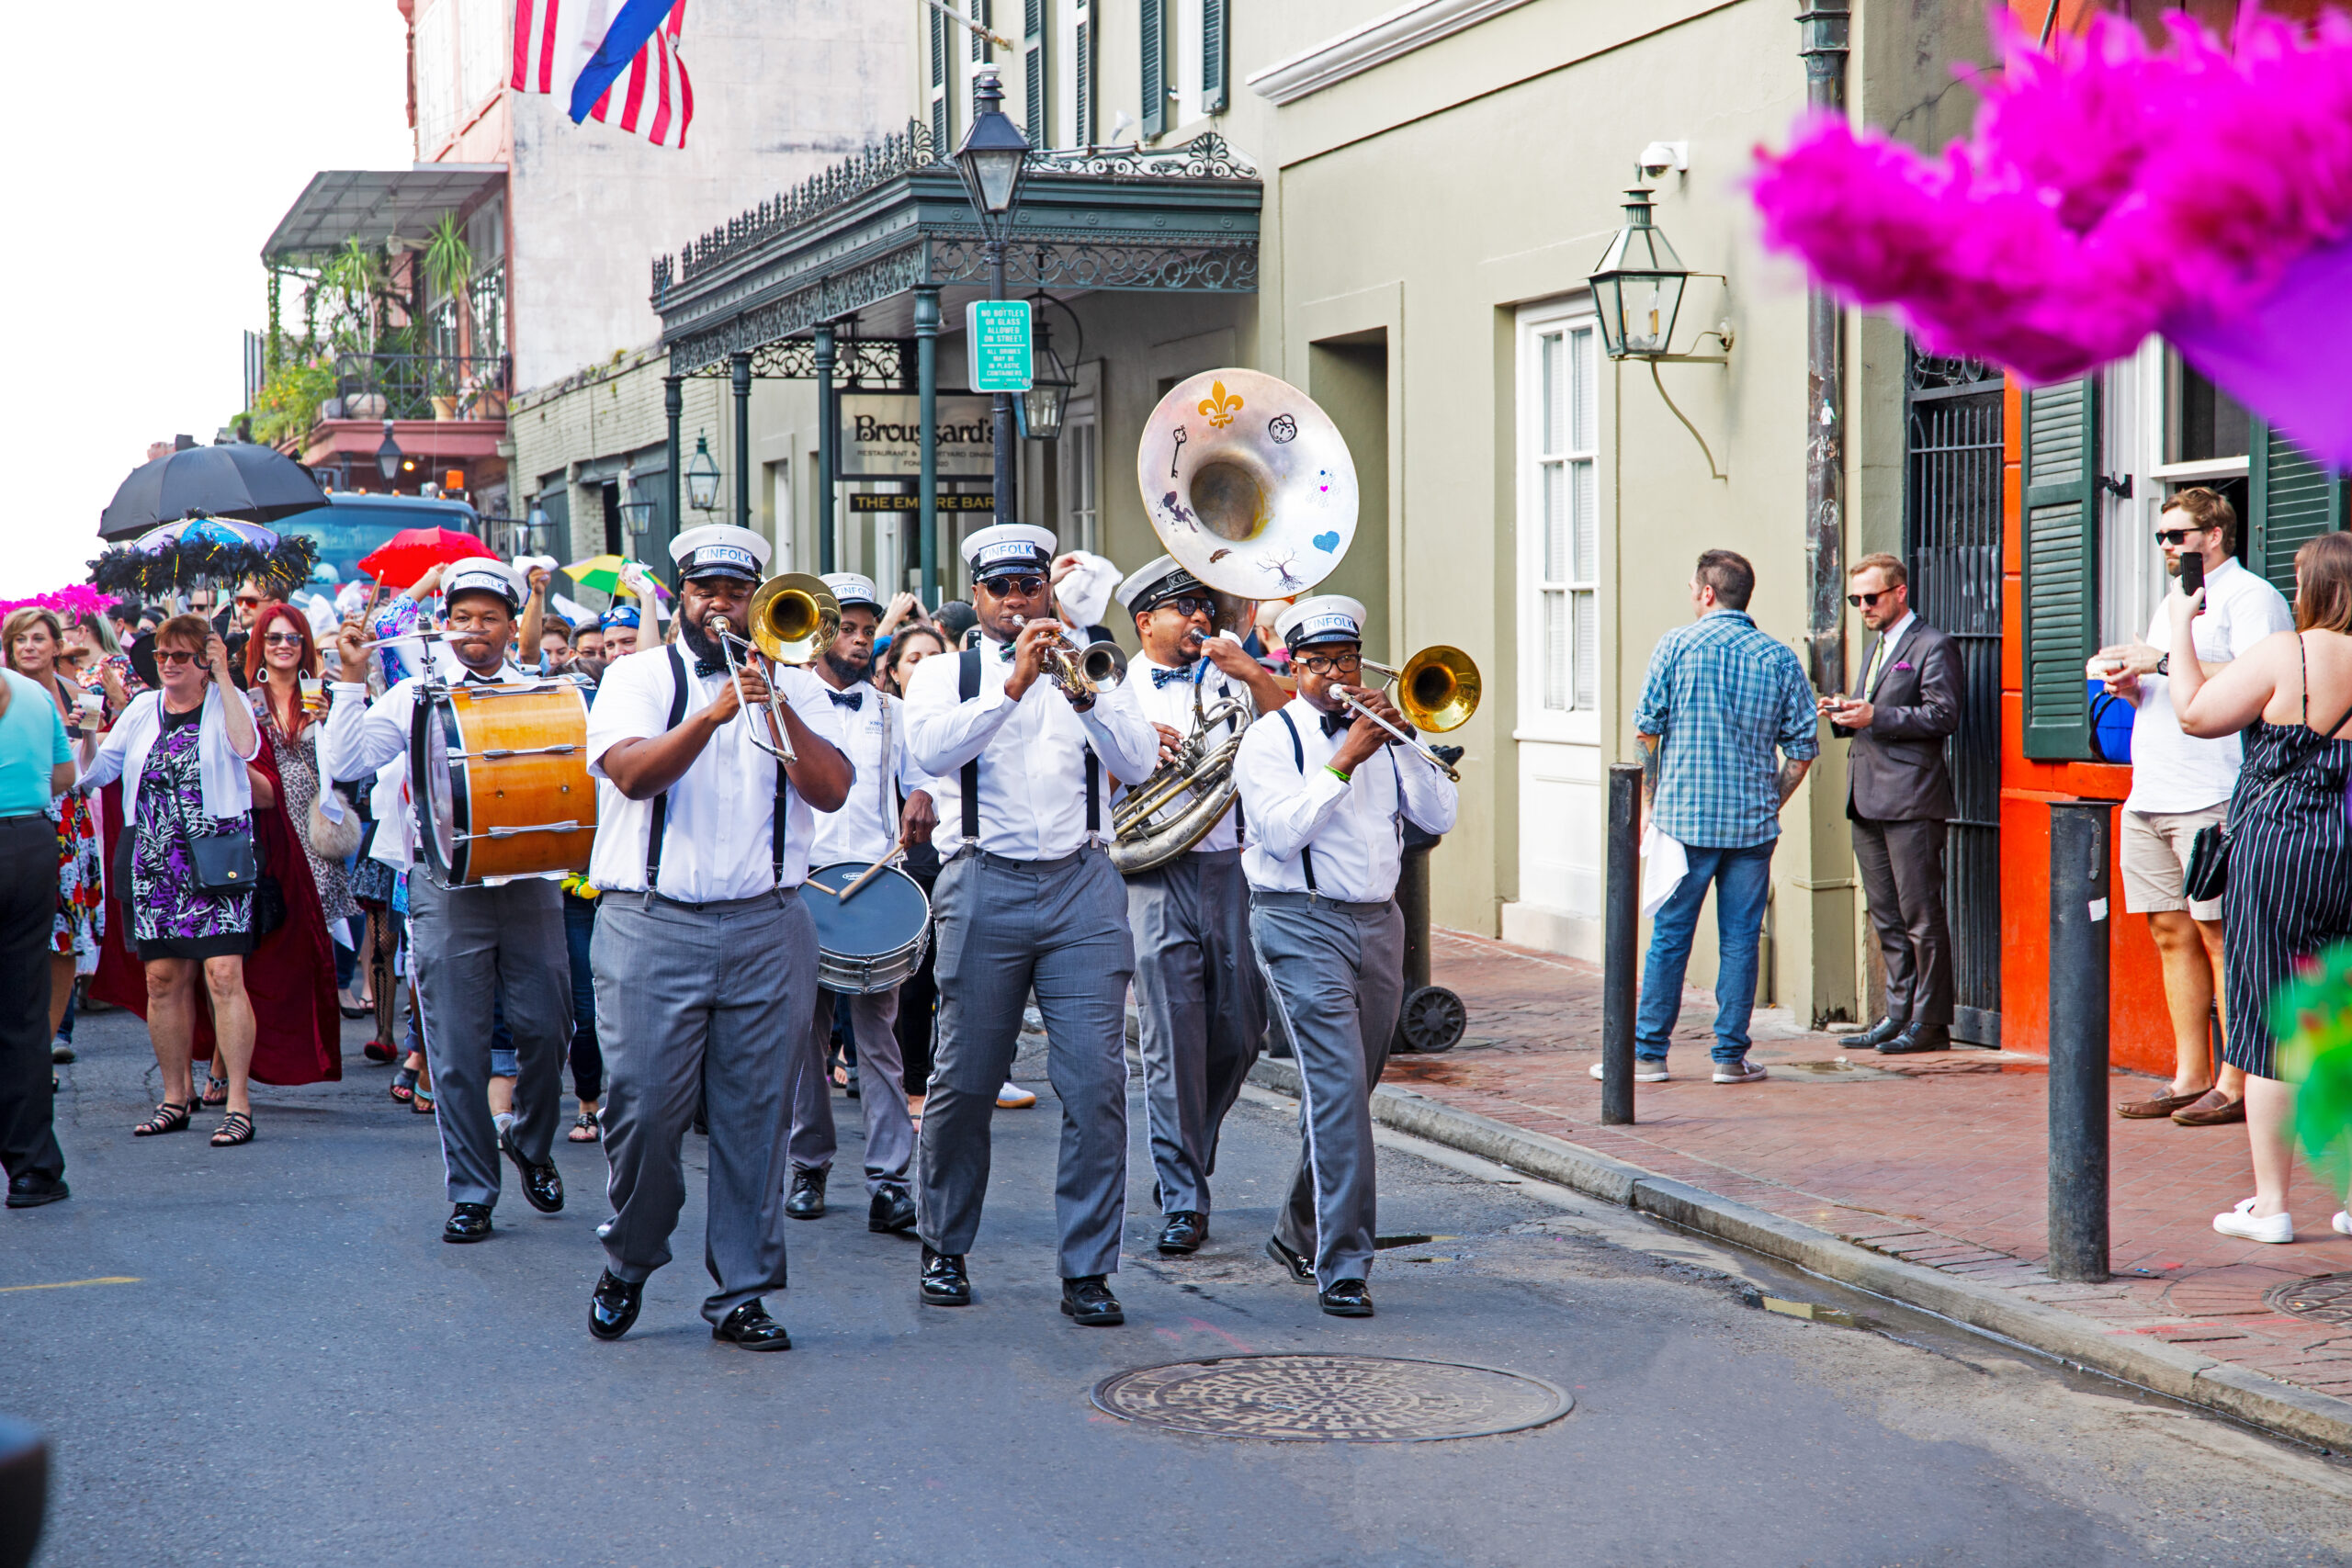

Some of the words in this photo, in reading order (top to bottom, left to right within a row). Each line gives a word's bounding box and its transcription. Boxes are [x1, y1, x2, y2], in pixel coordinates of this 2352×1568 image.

[855, 496, 889, 509] THE
[894, 496, 957, 509] EMRE
[962, 496, 994, 509] BAR
[698, 548, 752, 565] KINFOLK
[982, 544, 1033, 560] KINFOLK
[457, 577, 503, 590] KINFOLK
[832, 586, 873, 597] KINFOLK
[1305, 616, 1353, 630] KINFOLK
